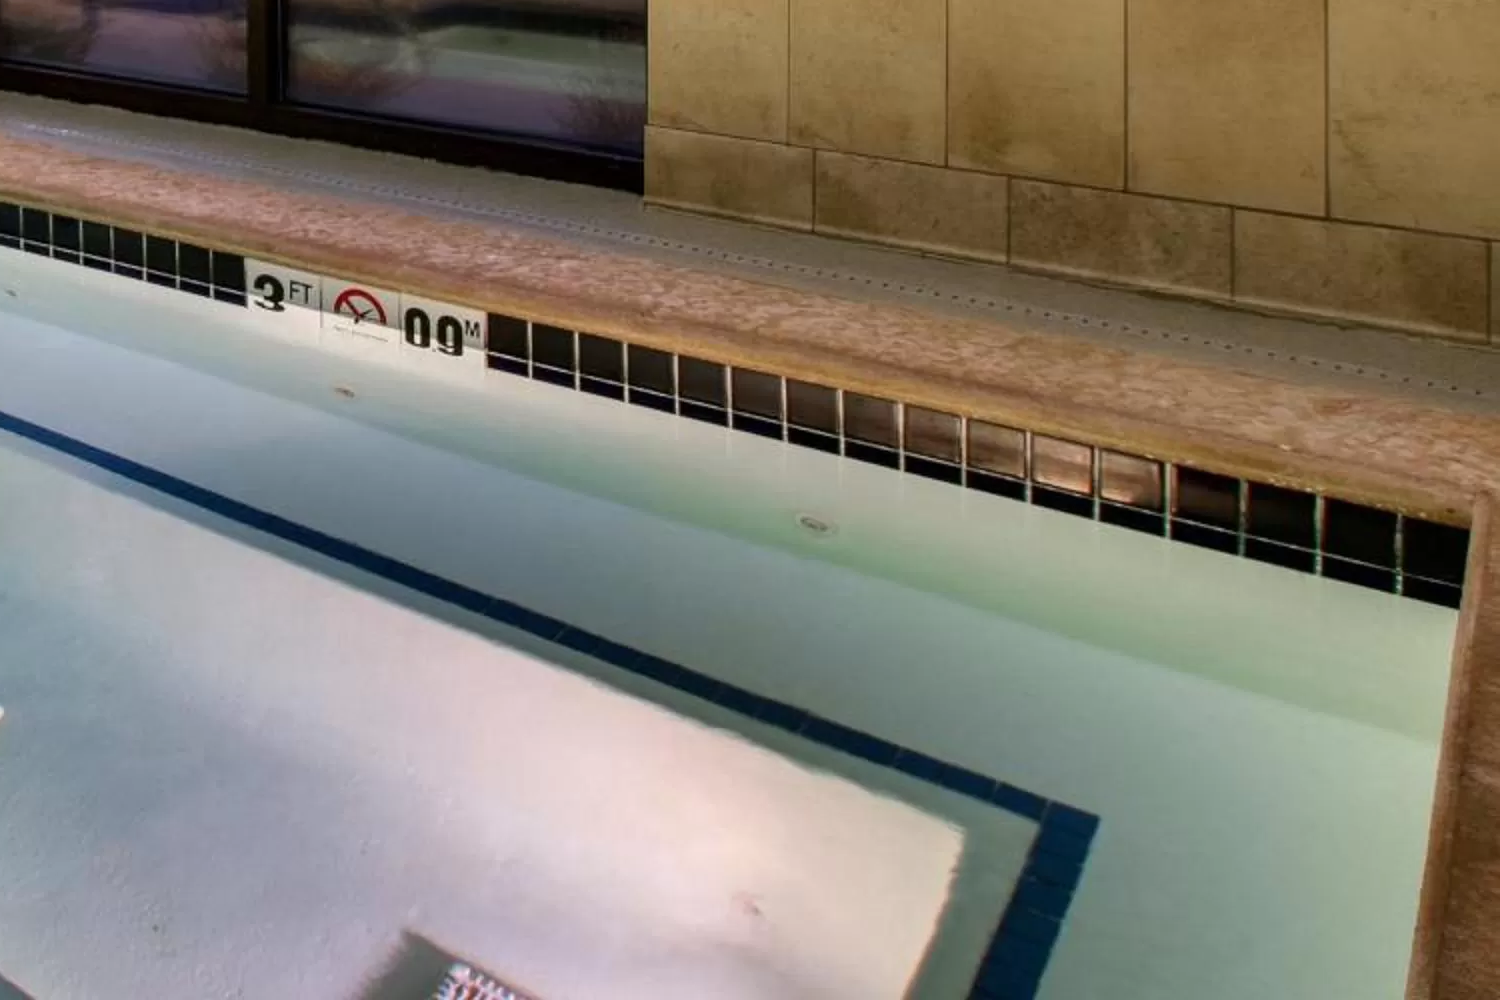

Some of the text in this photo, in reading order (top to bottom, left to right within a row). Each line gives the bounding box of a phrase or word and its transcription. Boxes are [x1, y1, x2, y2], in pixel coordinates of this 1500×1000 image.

[253, 273, 313, 312] 3 FT
[465, 319, 480, 338] M
